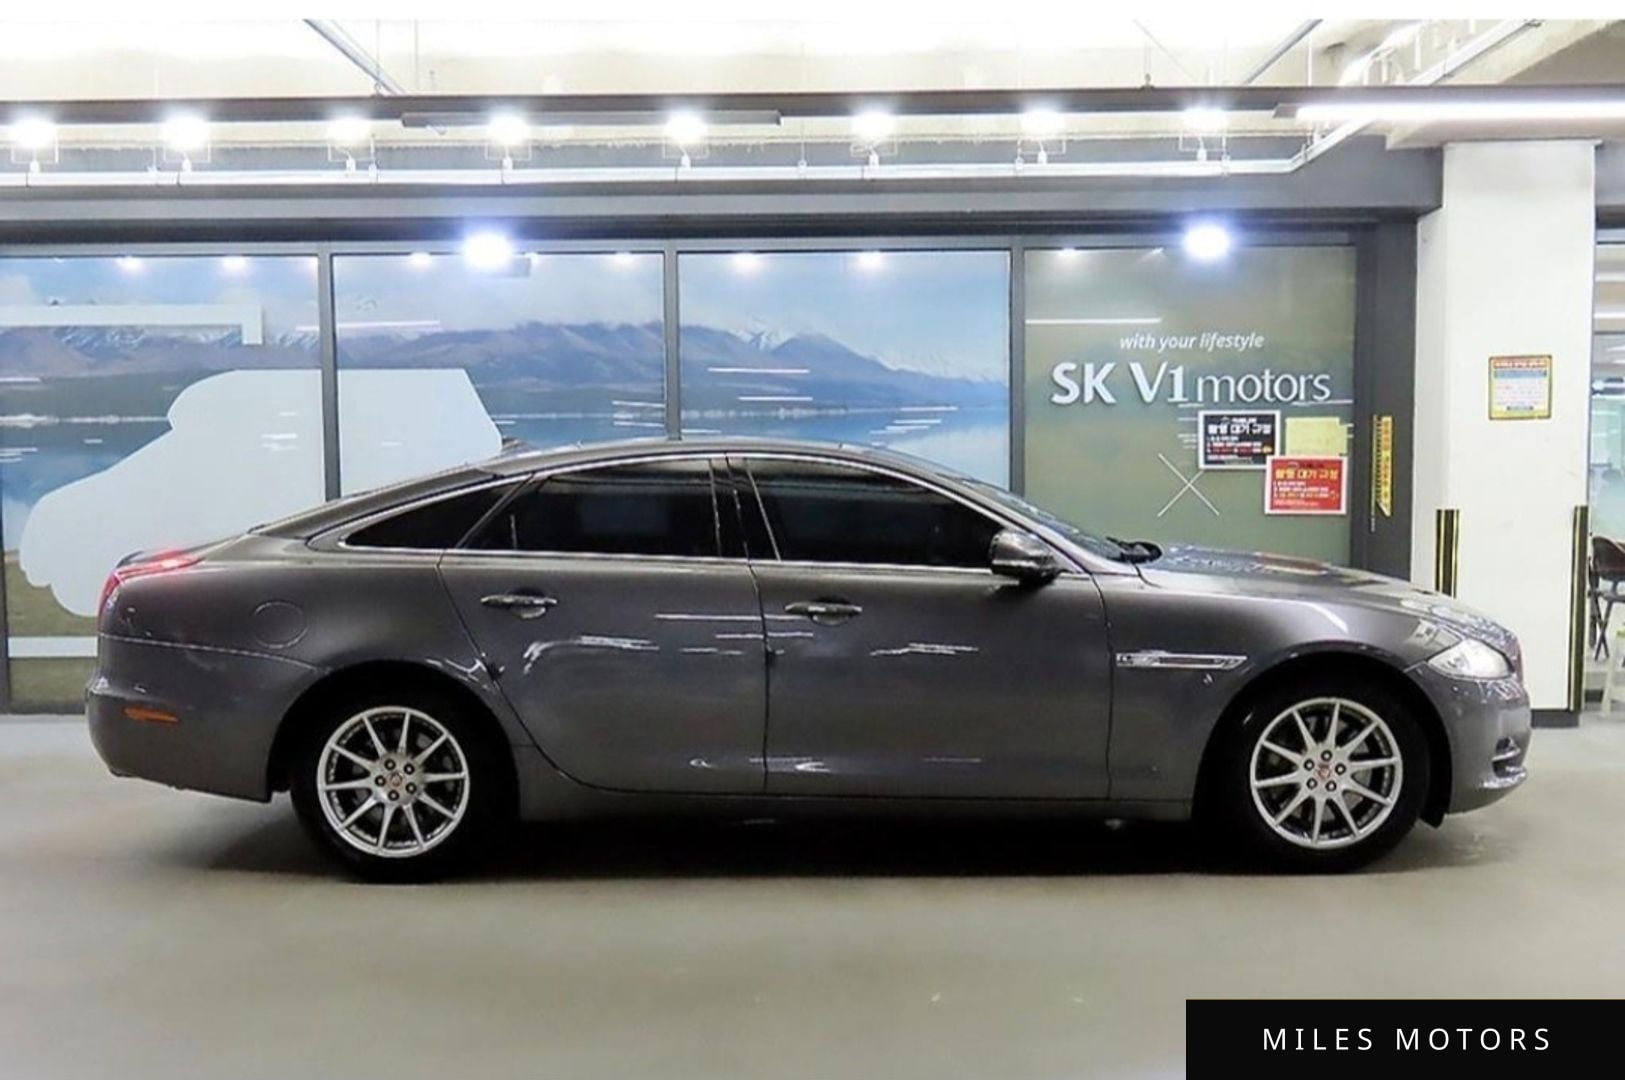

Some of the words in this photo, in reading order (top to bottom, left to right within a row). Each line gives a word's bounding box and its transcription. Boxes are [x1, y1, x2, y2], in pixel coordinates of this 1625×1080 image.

[1120, 333, 1155, 350] with
[1158, 335, 1197, 354] your
[1200, 332, 1265, 353] lifestyle
[1051, 361, 1117, 405] SK
[1128, 361, 1188, 404] V1
[1197, 368, 1331, 403] motors
